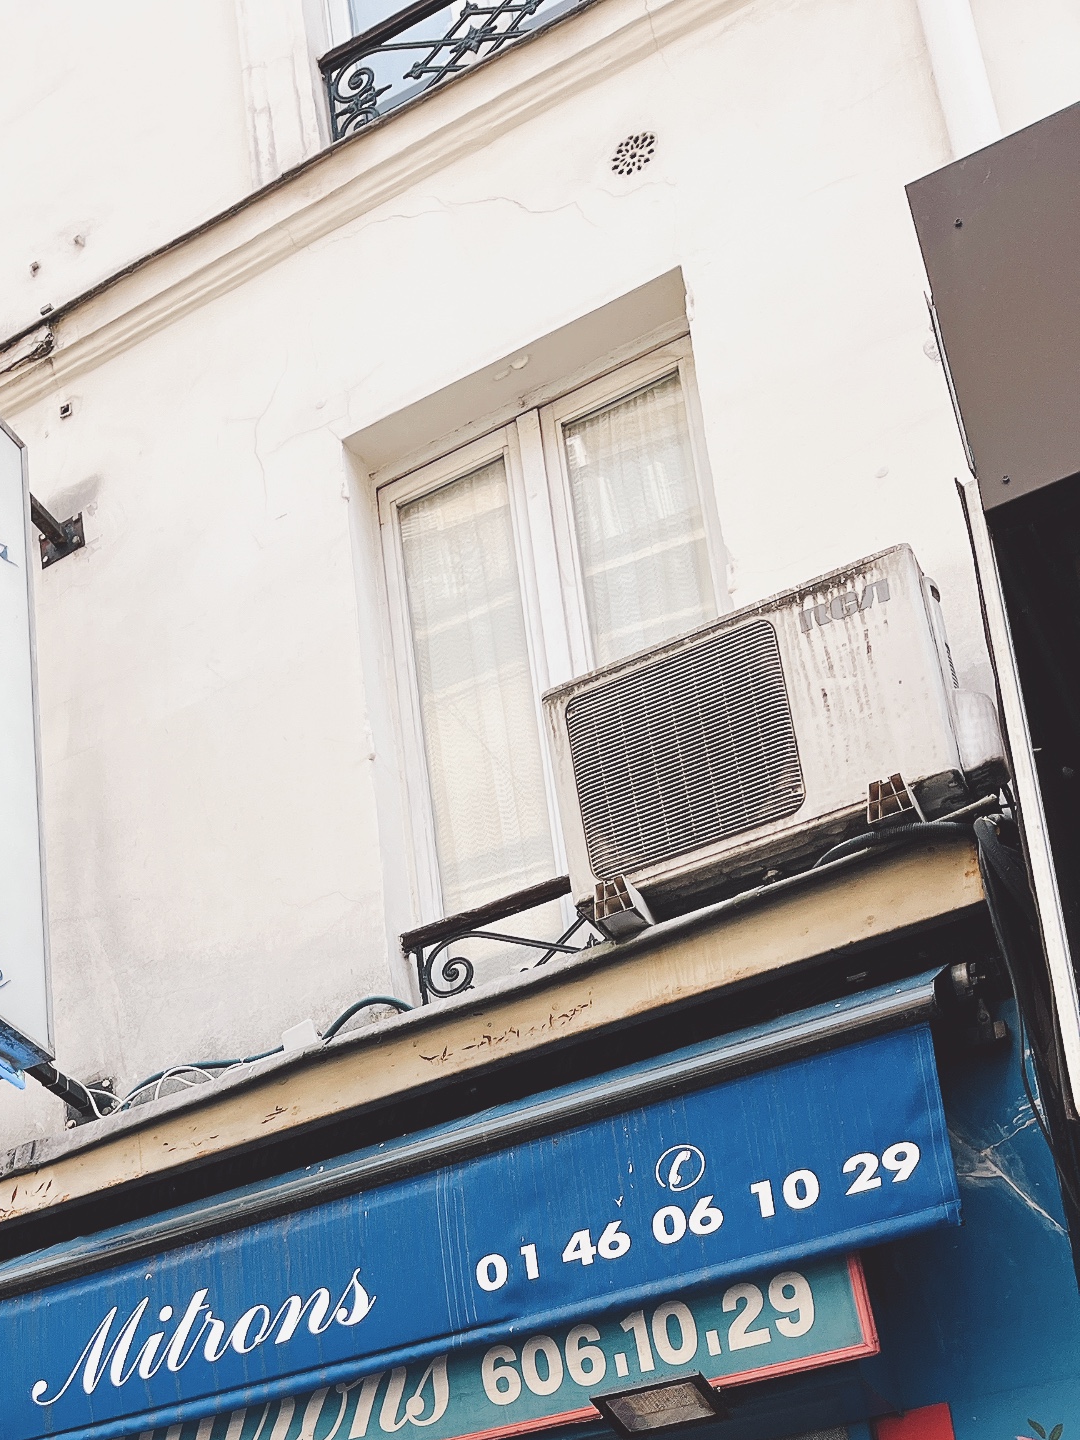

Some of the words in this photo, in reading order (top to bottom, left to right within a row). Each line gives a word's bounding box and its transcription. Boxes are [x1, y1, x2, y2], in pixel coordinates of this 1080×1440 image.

[799, 578, 890, 633] RCA
[561, 1220, 631, 1266] 46
[652, 1195, 724, 1245] 06
[751, 1169, 819, 1218] 10
[842, 1141, 921, 1196] 29
[32, 1266, 377, 1406] Mitrons
